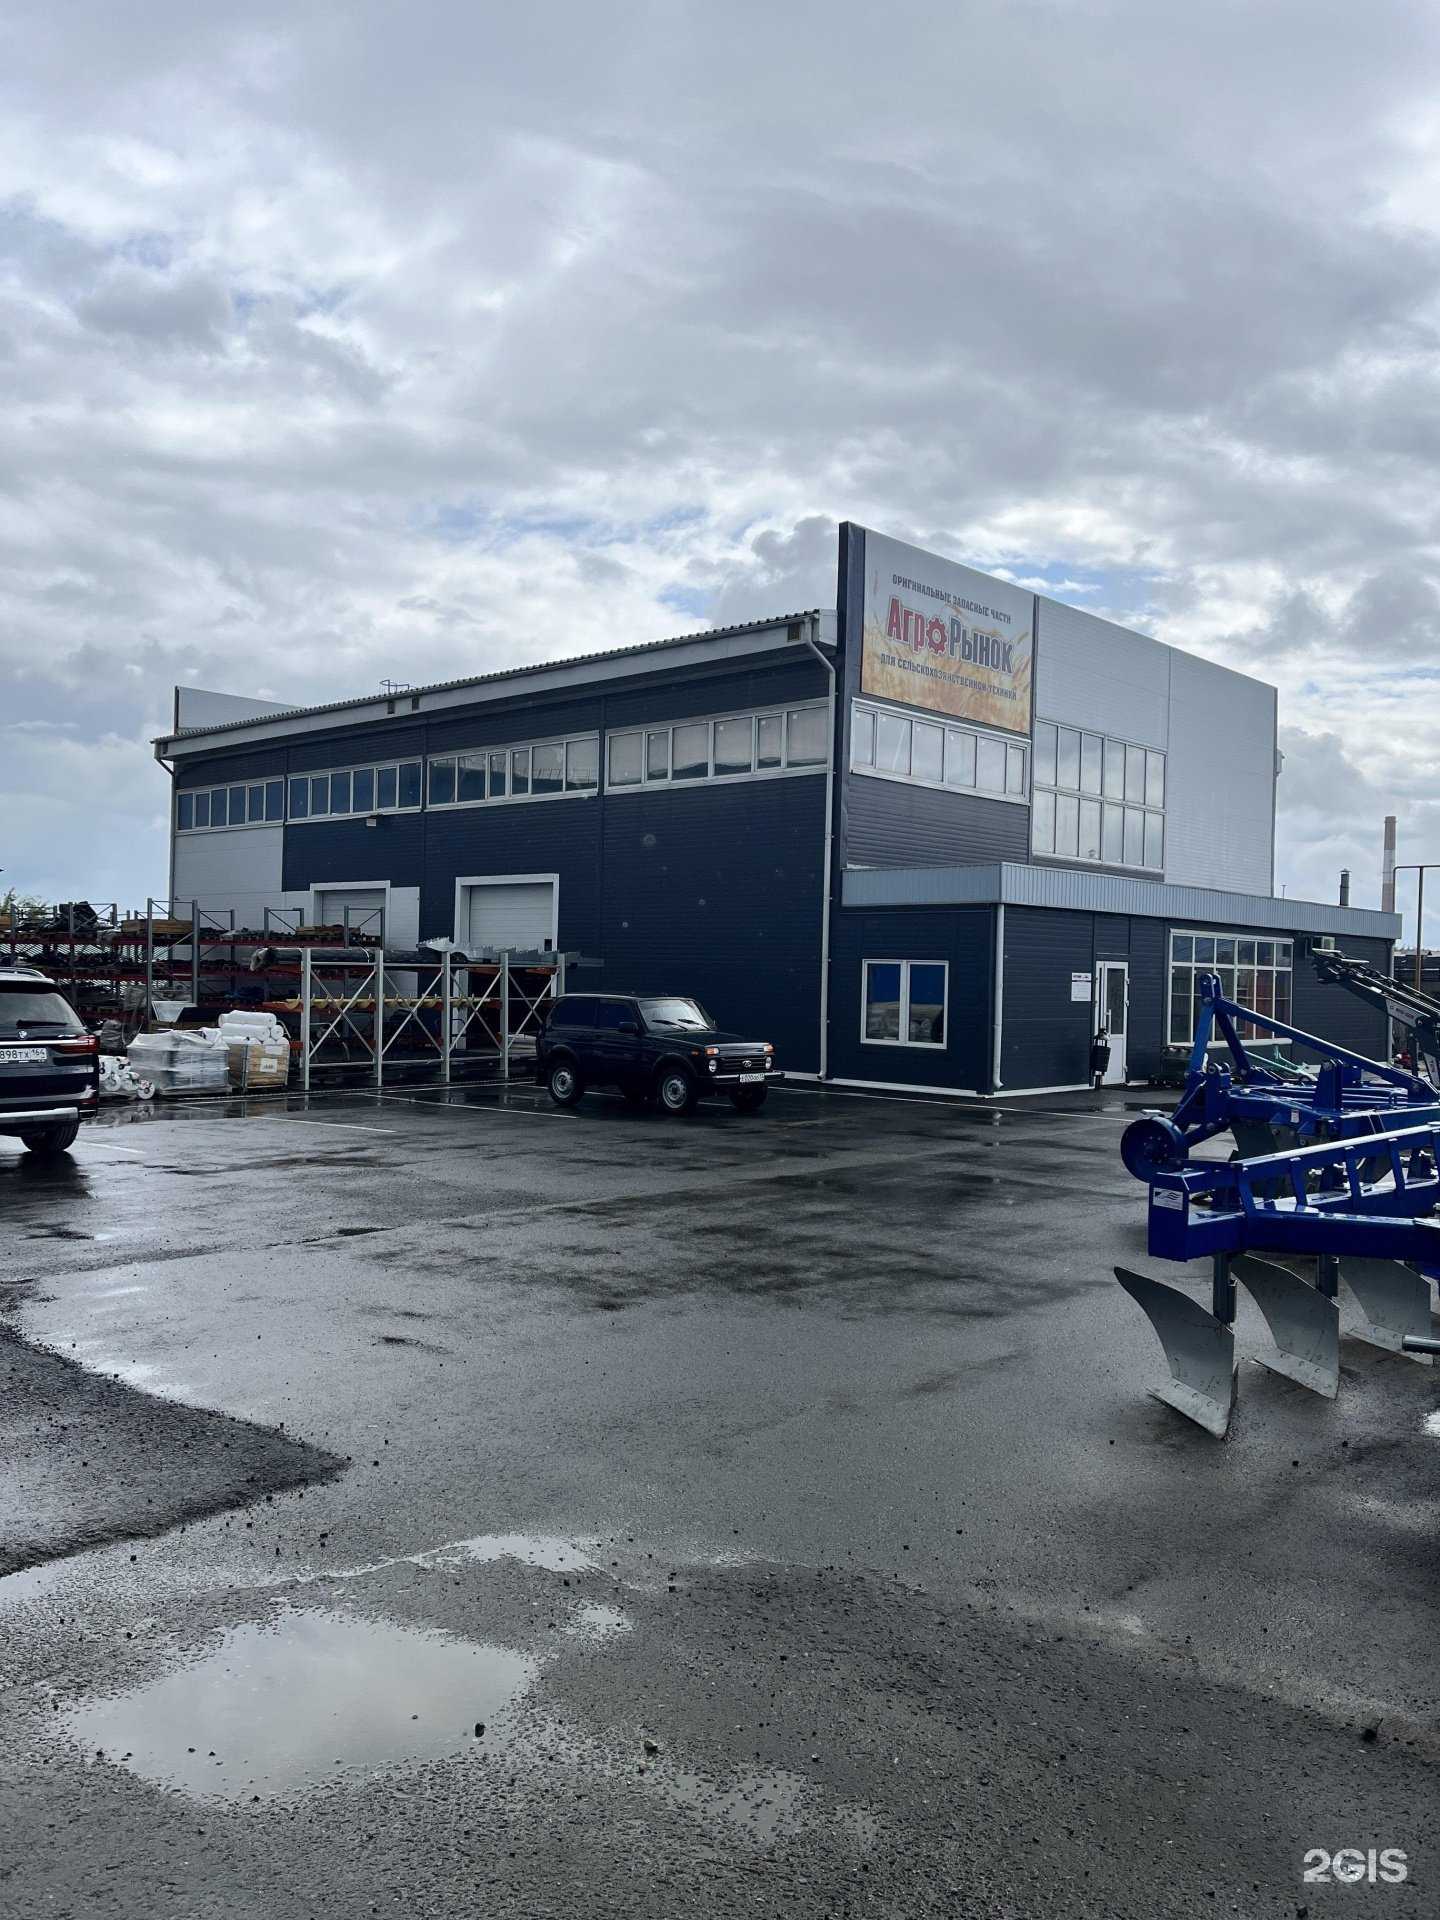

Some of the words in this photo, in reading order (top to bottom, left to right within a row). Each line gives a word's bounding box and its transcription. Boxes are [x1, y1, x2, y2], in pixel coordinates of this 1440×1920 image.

[892, 574, 951, 603] ОРИГИНАЛЬНЫЕ
[952, 595, 990, 617] ЗАПАСНЫЕ
[990, 610, 1011, 625] ЧАСТИ
[880, 653, 896, 666] ДЛЯ
